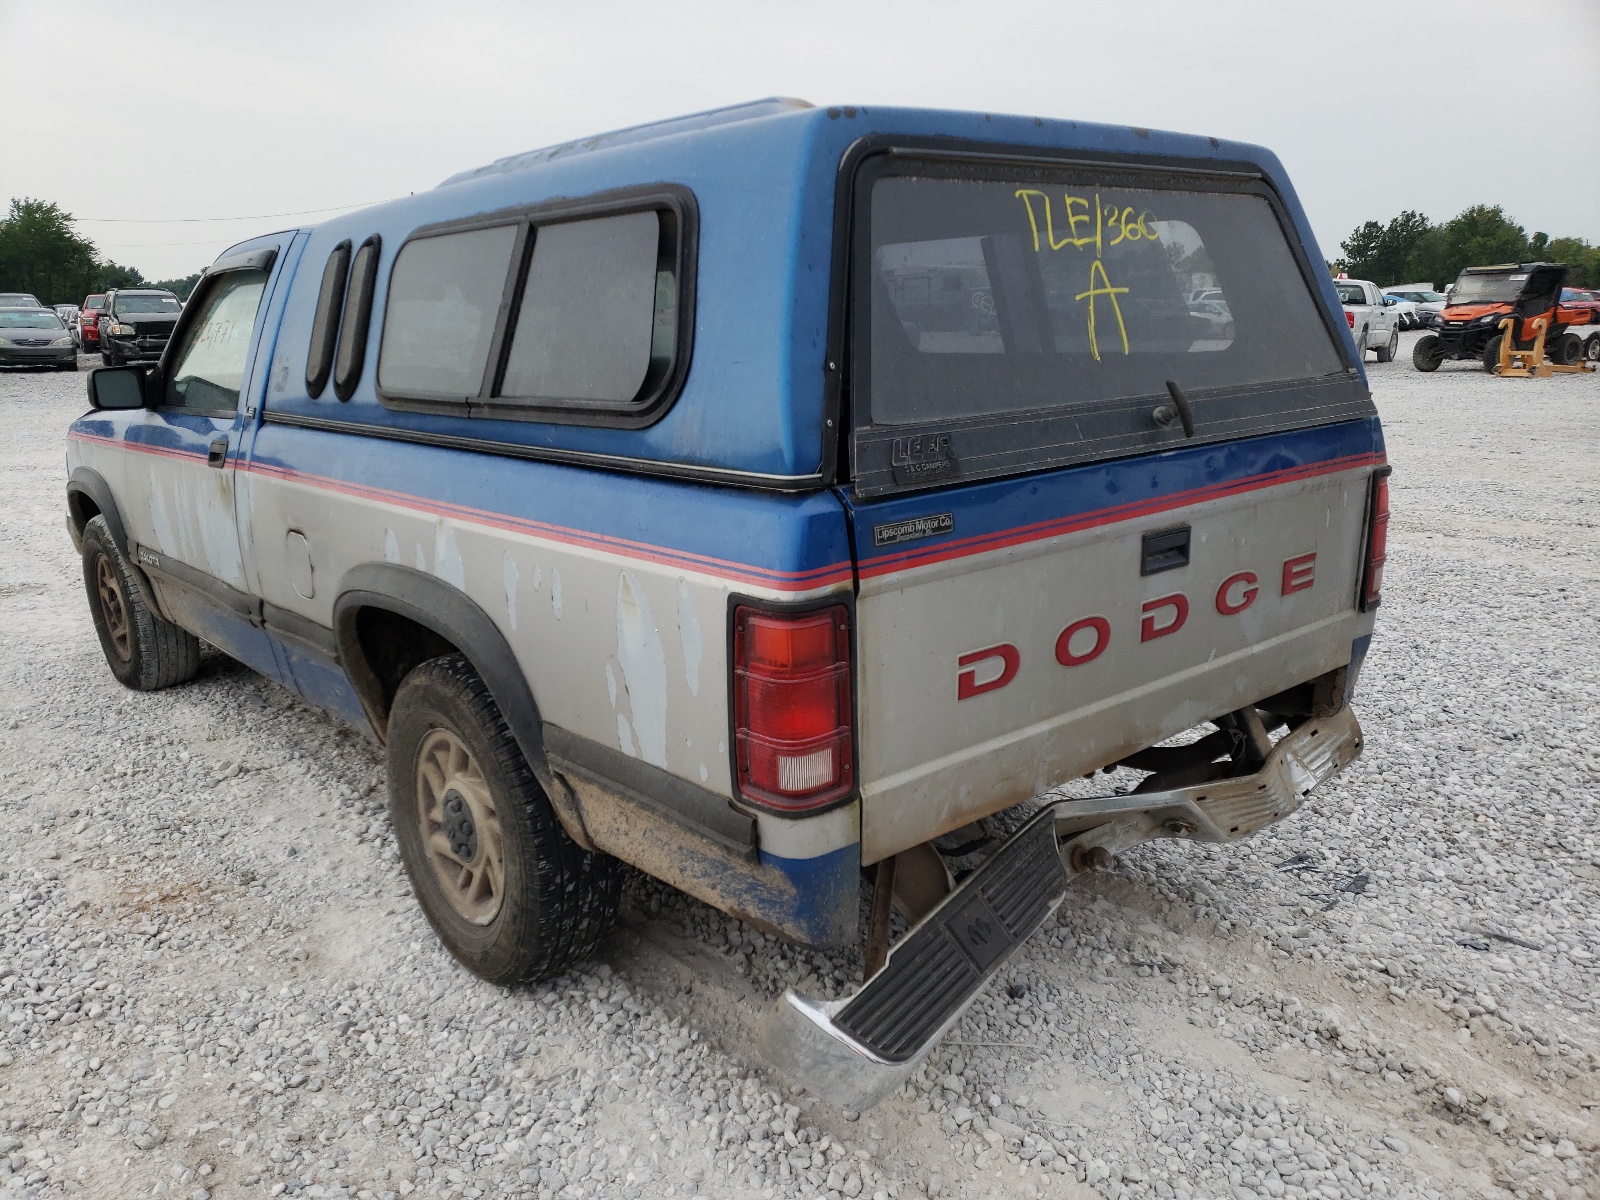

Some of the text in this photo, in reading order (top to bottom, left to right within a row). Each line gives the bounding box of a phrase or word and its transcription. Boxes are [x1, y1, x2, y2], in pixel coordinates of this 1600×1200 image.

[1076, 260, 1130, 361] A
[892, 433, 957, 467] LEER
[877, 523, 915, 540] Lipscomb
[916, 519, 939, 532] Motor
[957, 551, 1318, 701] DODGE
